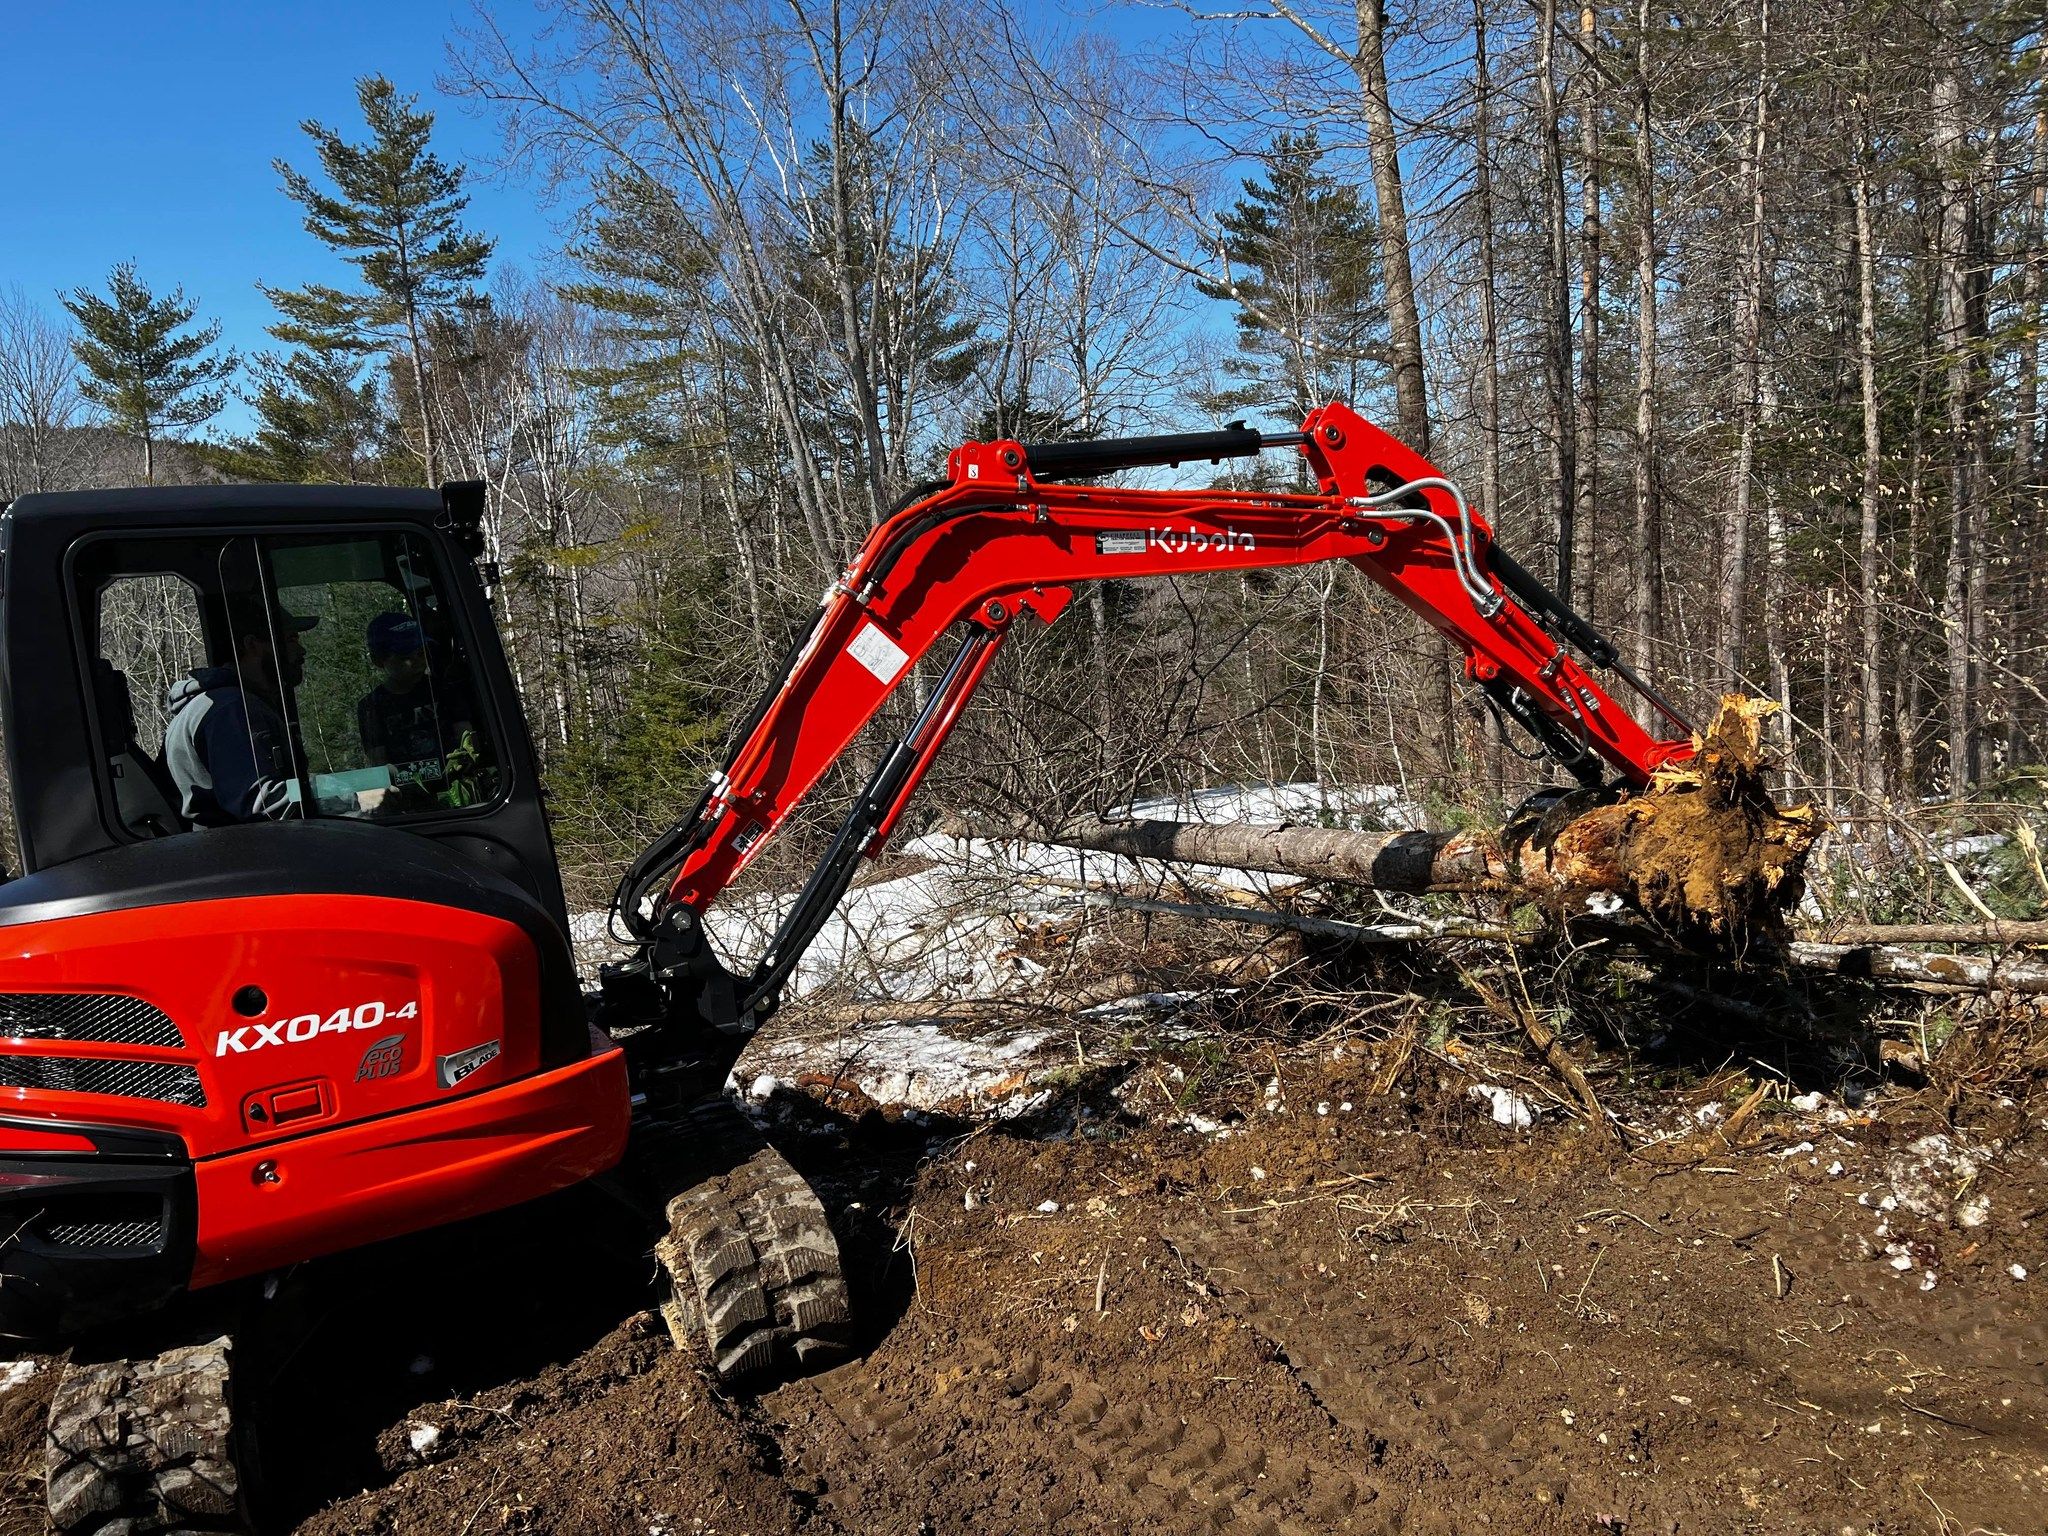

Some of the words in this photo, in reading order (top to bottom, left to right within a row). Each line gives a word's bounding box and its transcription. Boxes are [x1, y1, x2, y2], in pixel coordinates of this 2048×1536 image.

[1149, 525, 1256, 554] Kubota
[215, 1001, 418, 1057] KX040-4
[367, 1047, 403, 1065] eco
[454, 1049, 498, 1082] BLADE
[354, 1062, 401, 1084] PLUS
